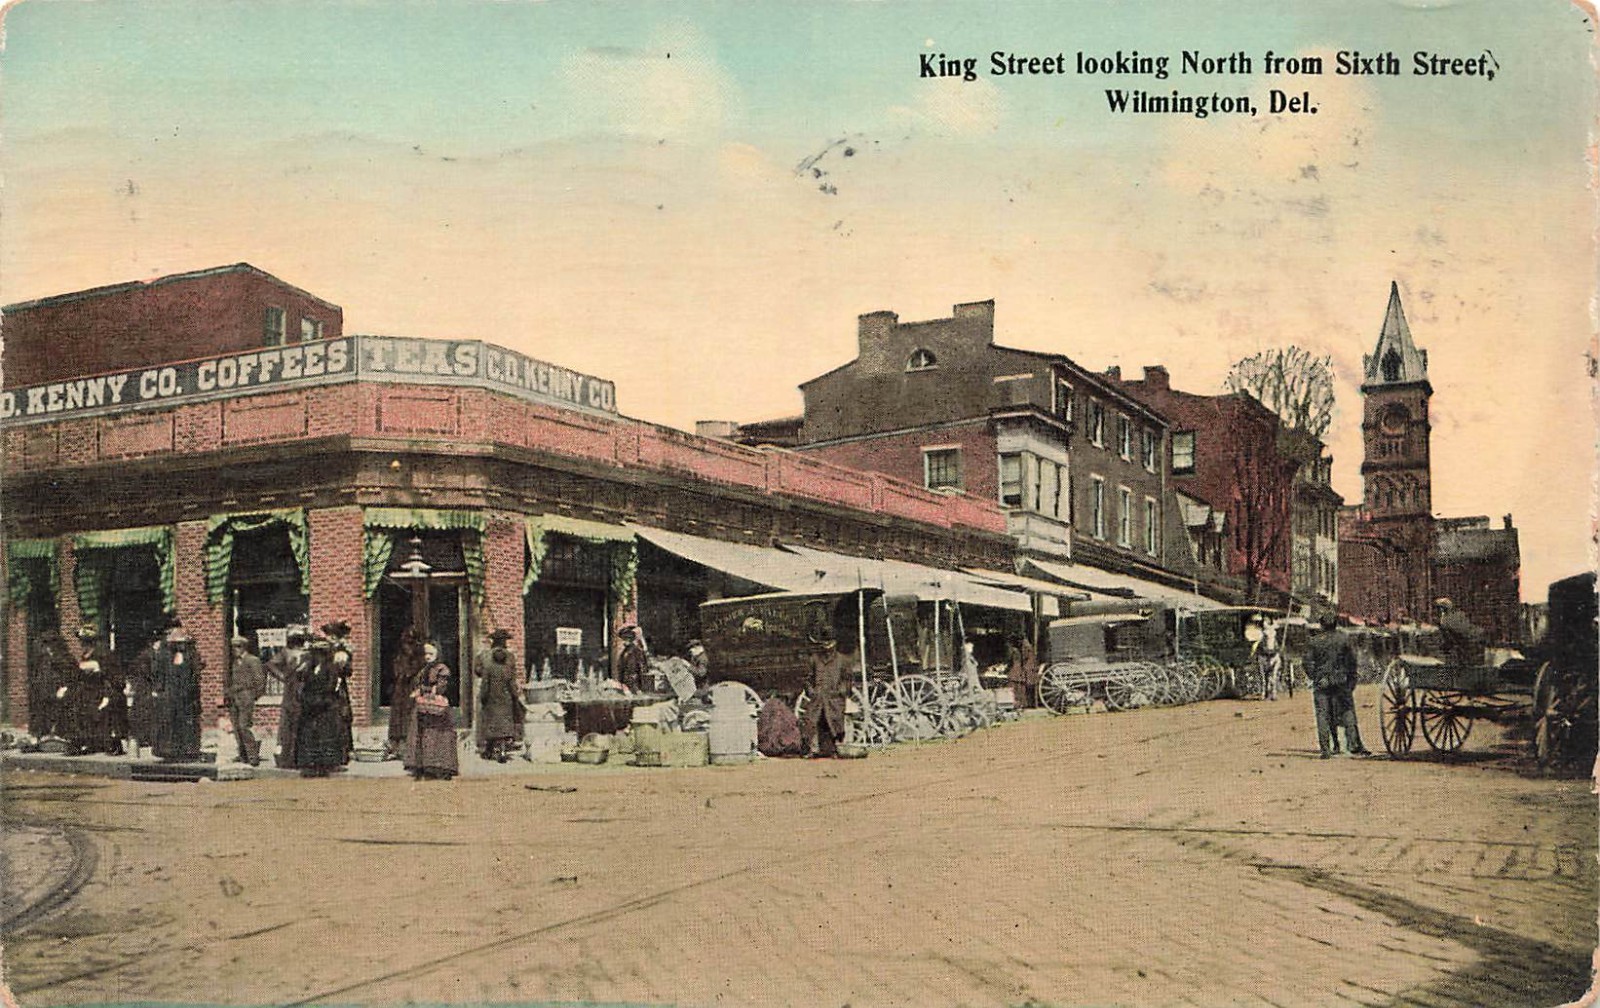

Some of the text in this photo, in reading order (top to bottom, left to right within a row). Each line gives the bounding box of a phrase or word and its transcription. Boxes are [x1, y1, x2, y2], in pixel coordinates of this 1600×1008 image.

[140, 368, 182, 399] CO.
[198, 341, 348, 391] COFFEES
[361, 338, 480, 376] TEAS
